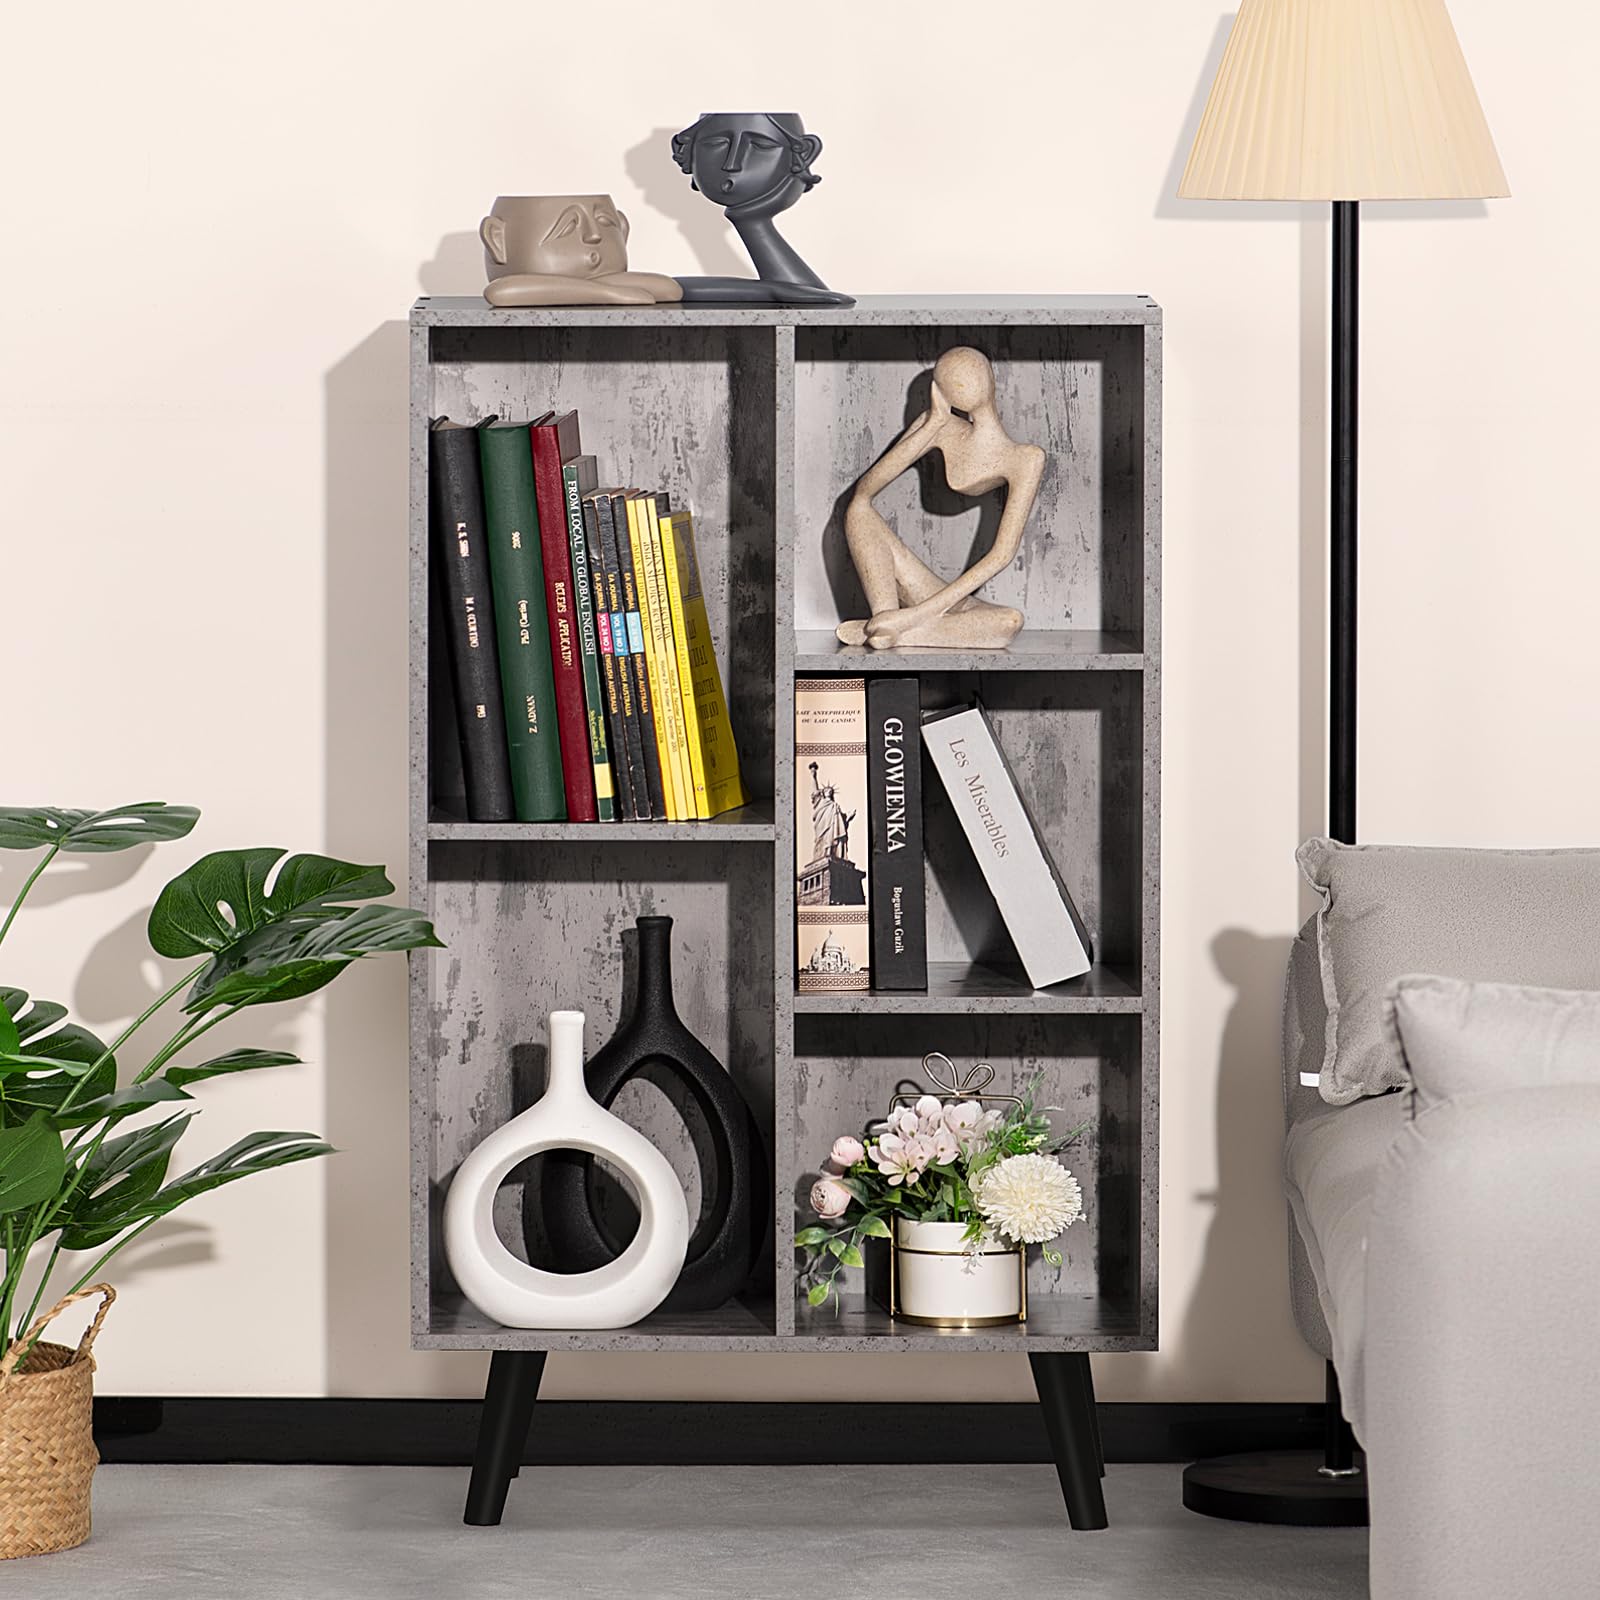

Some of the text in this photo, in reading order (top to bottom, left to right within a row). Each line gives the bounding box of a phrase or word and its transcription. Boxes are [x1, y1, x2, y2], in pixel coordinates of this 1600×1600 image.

[567, 480, 594, 655] FROM LOCAL TO GLOBAL ENGLISH
[594, 572, 604, 610] EA JOURNAL
[607, 573, 618, 611] EA JOURNAL
[623, 572, 634, 610] EA JOURNAL
[557, 618, 573, 666] APPLICATIO
[602, 636, 609, 646] NO
[616, 637, 622, 647] NO
[604, 654, 617, 713] ENGLISH AUSTRALIA
[618, 656, 632, 716] ENGLISH AUSTRALIA
[634, 653, 649, 713] ENGLISH AUSTRALIA
[526, 694, 537, 723] ADNAN
[949, 738, 1009, 858] Les Miserables
[894, 928, 904, 954] Guzik
